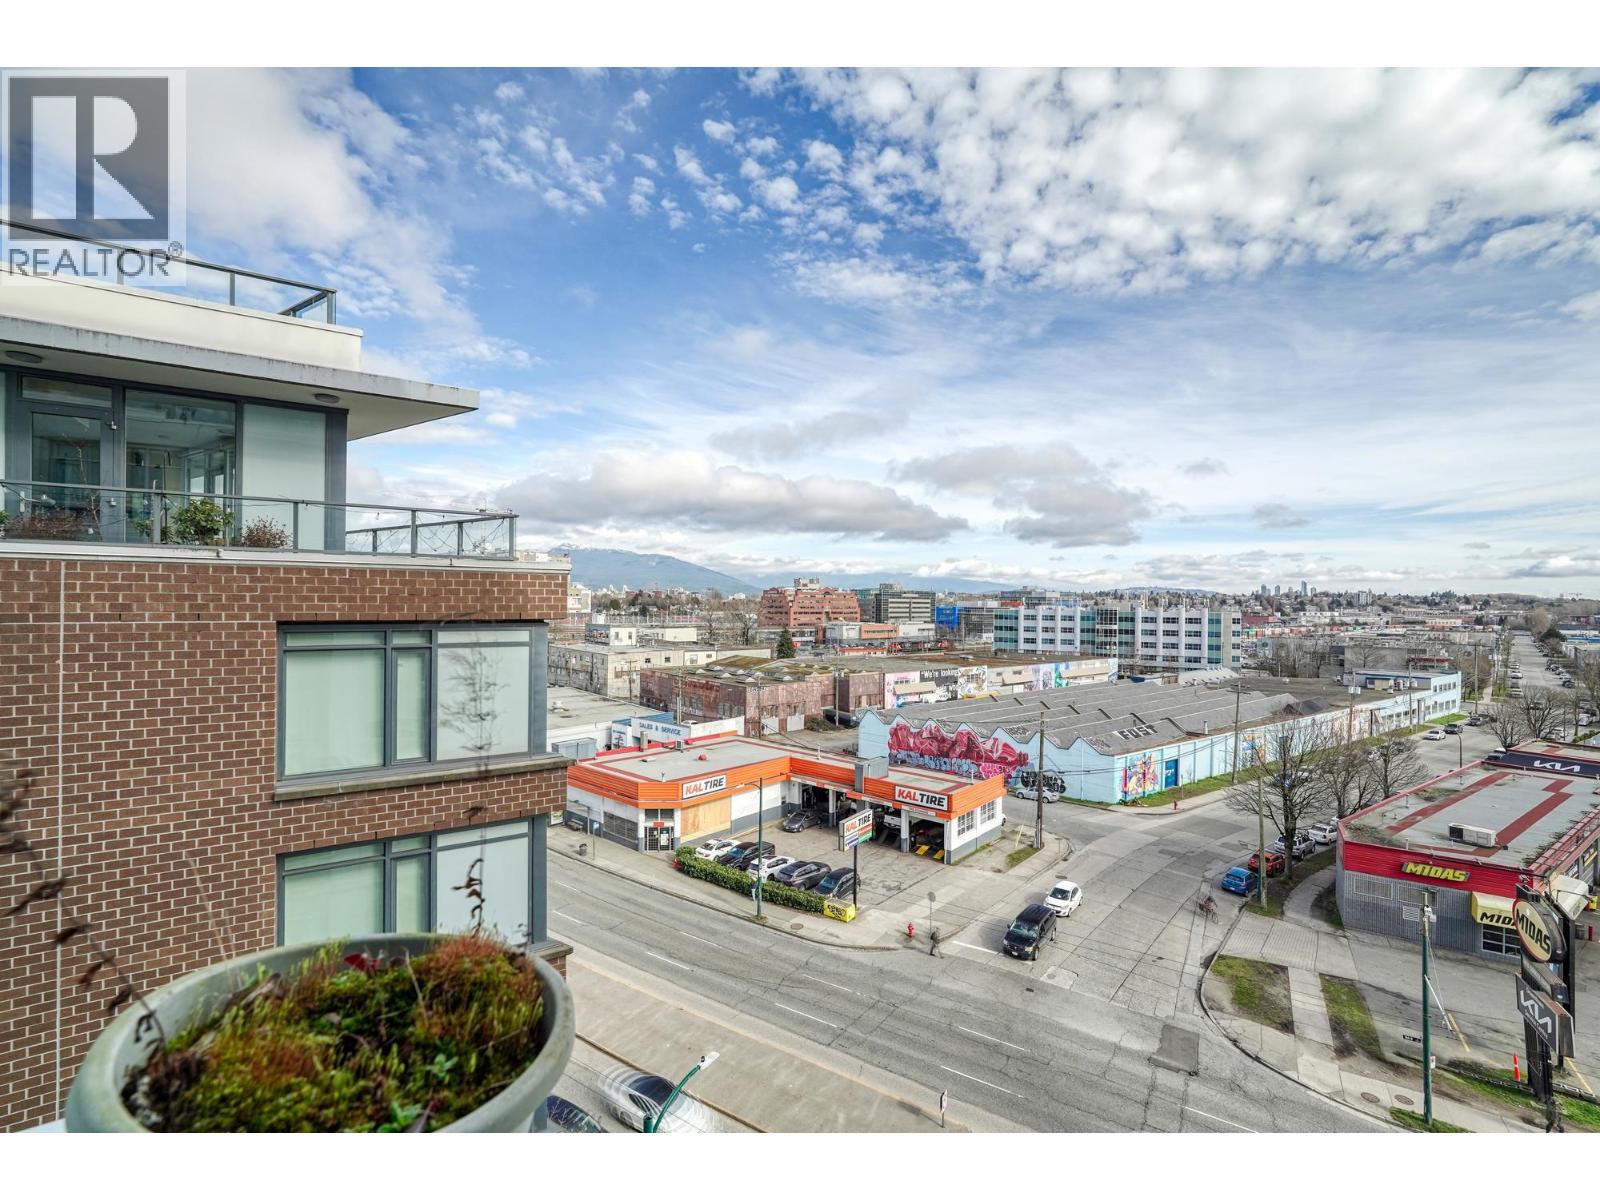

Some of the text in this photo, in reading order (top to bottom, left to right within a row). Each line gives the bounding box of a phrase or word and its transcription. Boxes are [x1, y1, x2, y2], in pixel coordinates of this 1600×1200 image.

[1406, 862, 1466, 882] MIDAS
[1480, 911, 1516, 926] MID
[1517, 908, 1551, 955] MIDAS
